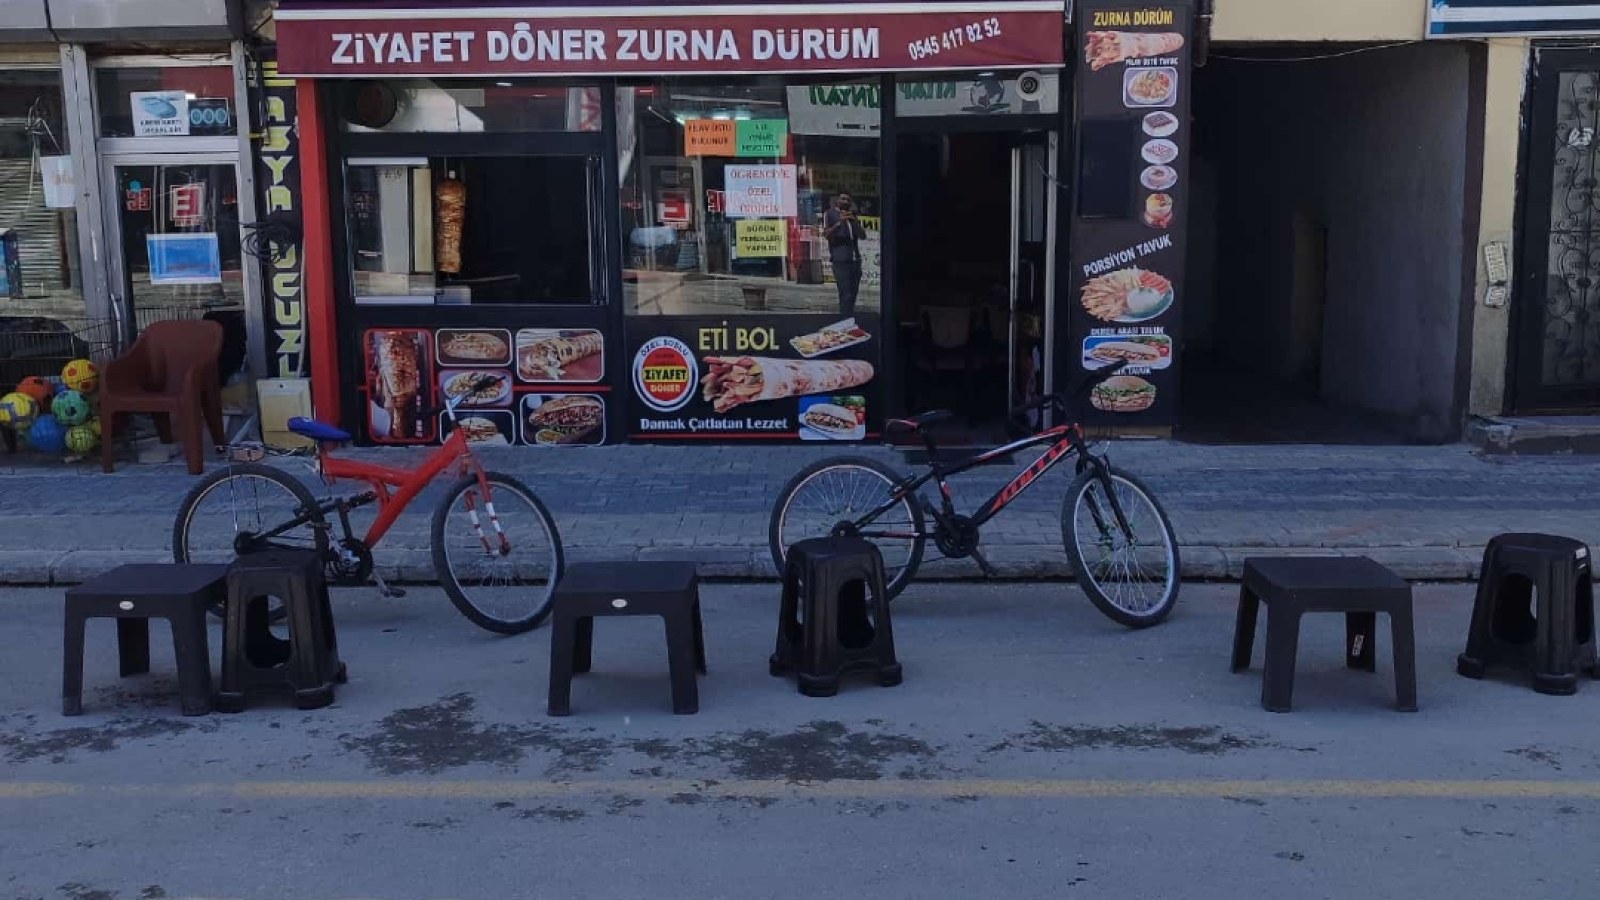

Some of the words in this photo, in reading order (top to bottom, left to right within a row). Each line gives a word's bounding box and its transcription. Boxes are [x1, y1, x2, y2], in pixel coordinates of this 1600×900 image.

[1094, 11, 1130, 26] ZURNA
[1134, 8, 1173, 25] DÜRÜM
[616, 29, 740, 61] ZURNA
[752, 27, 880, 60] DÜRÜM
[908, 35, 940, 60] 0545
[942, 28, 964, 50] 417
[966, 23, 984, 42] 82
[984, 18, 1002, 37] 52
[1083, 246, 1136, 277] PORSİYON
[1136, 234, 1172, 256] TAVUK
[699, 320, 728, 350] ETİ
[735, 327, 780, 350] BOL
[640, 418, 686, 430] Damak
[688, 418, 743, 433] Çatlatan
[746, 417, 788, 430] Lezzet
